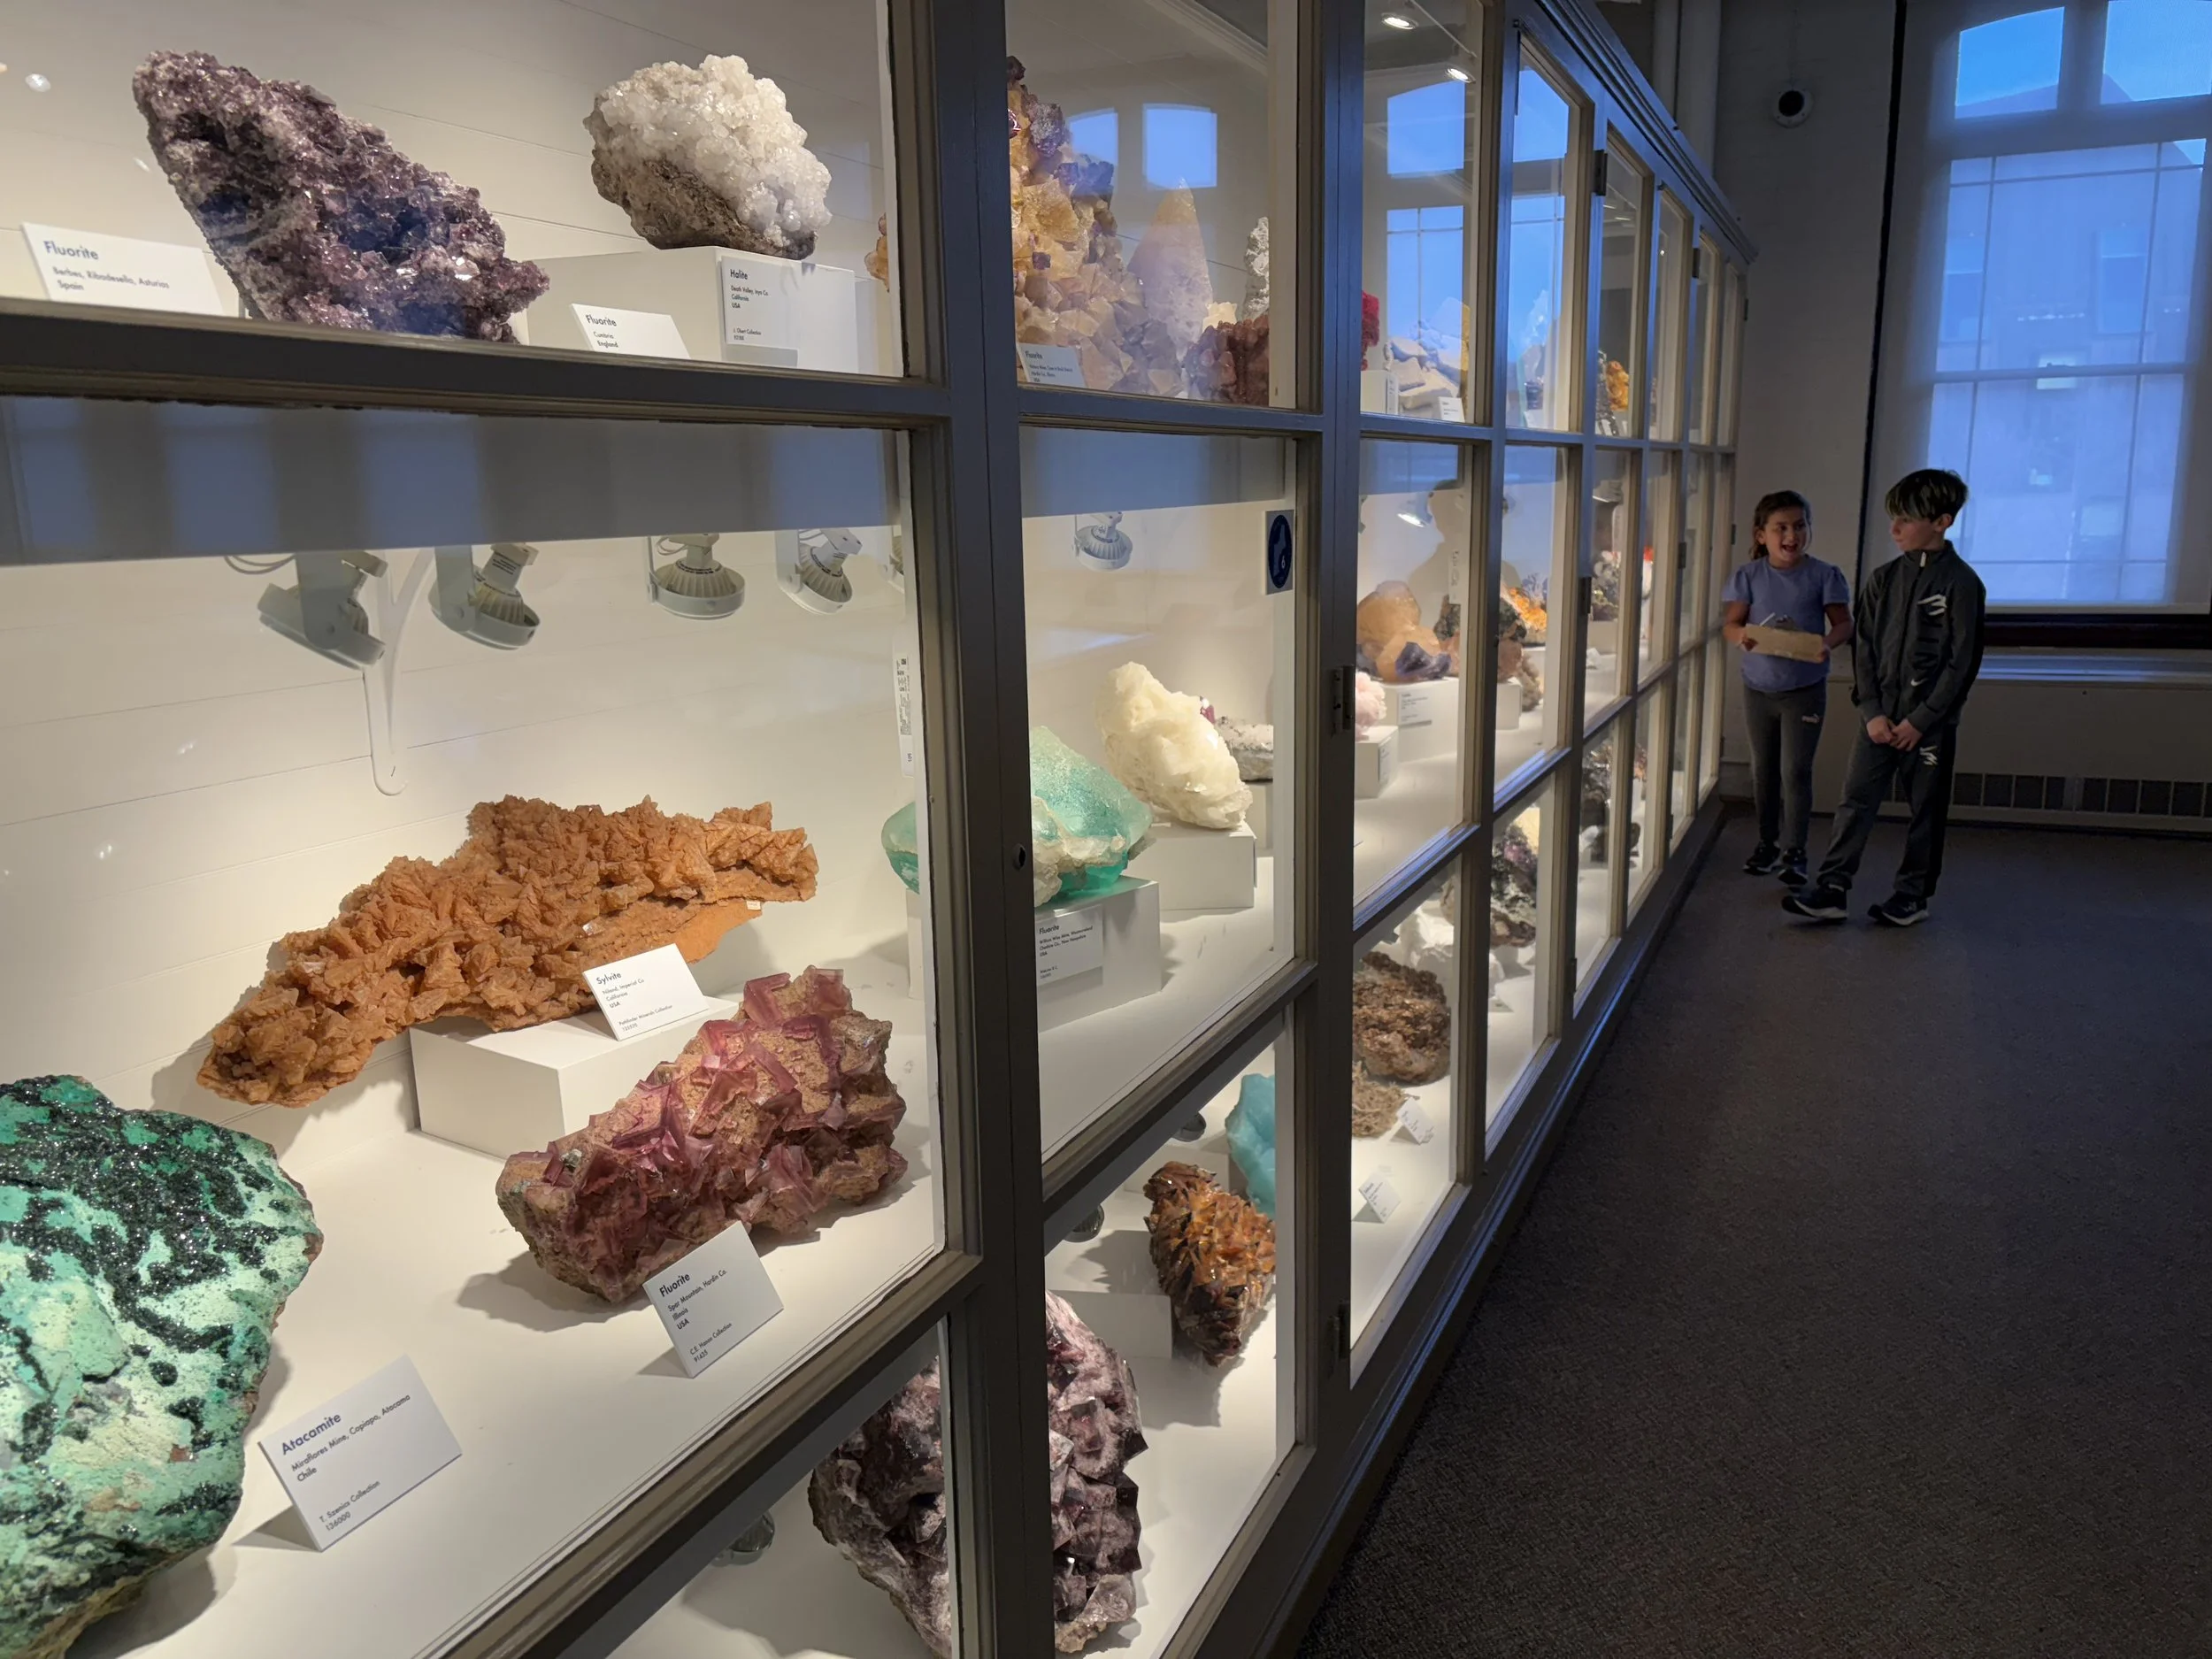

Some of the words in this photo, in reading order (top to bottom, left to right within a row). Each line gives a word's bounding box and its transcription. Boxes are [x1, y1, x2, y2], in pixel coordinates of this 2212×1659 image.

[43, 240, 99, 260] Fluorite
[730, 268, 749, 280] Halite
[57, 280, 84, 291] Spain
[585, 314, 618, 326] Fluorite
[596, 340, 618, 349] England
[595, 972, 622, 985] Sylvite
[659, 1273, 690, 1298] Fluorite
[668, 1301, 680, 1312] Spar
[680, 1286, 704, 1303] Mountain,
[703, 1275, 719, 1287] Hardin
[672, 1308, 688, 1322] Illinois
[677, 1318, 690, 1330] USA
[281, 1413, 342, 1455] Atacamite
[291, 1446, 329, 1472] Miraflores
[328, 1432, 350, 1449] Mine,
[349, 1414, 381, 1436] Copiapo,
[381, 1394, 411, 1416] Atacama
[296, 1465, 318, 1482] Chile
[350, 1479, 381, 1502] Collection
